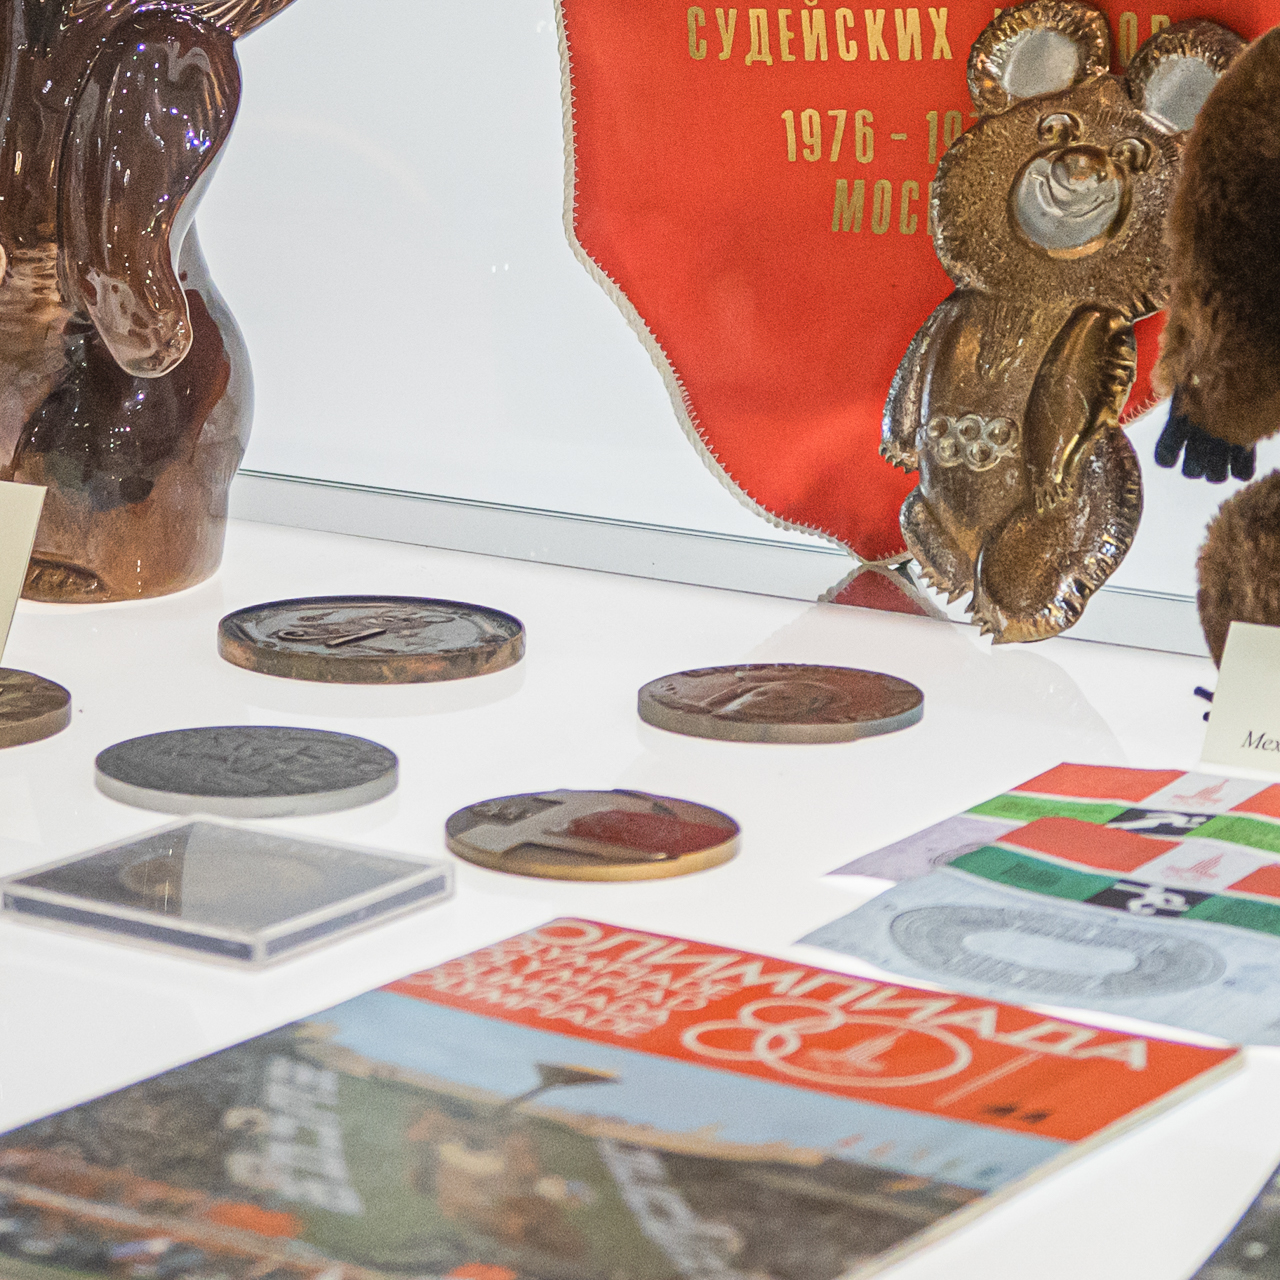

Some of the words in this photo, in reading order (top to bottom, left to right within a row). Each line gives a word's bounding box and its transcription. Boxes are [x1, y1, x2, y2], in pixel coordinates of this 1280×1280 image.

[687, 0, 953, 66] СУДЕЙСКИХ
[781, 108, 874, 164] 1976
[925, 109, 979, 164] 19
[831, 179, 938, 236] МОС
[532, 920, 1148, 1072] ОЛИМПИАДА
